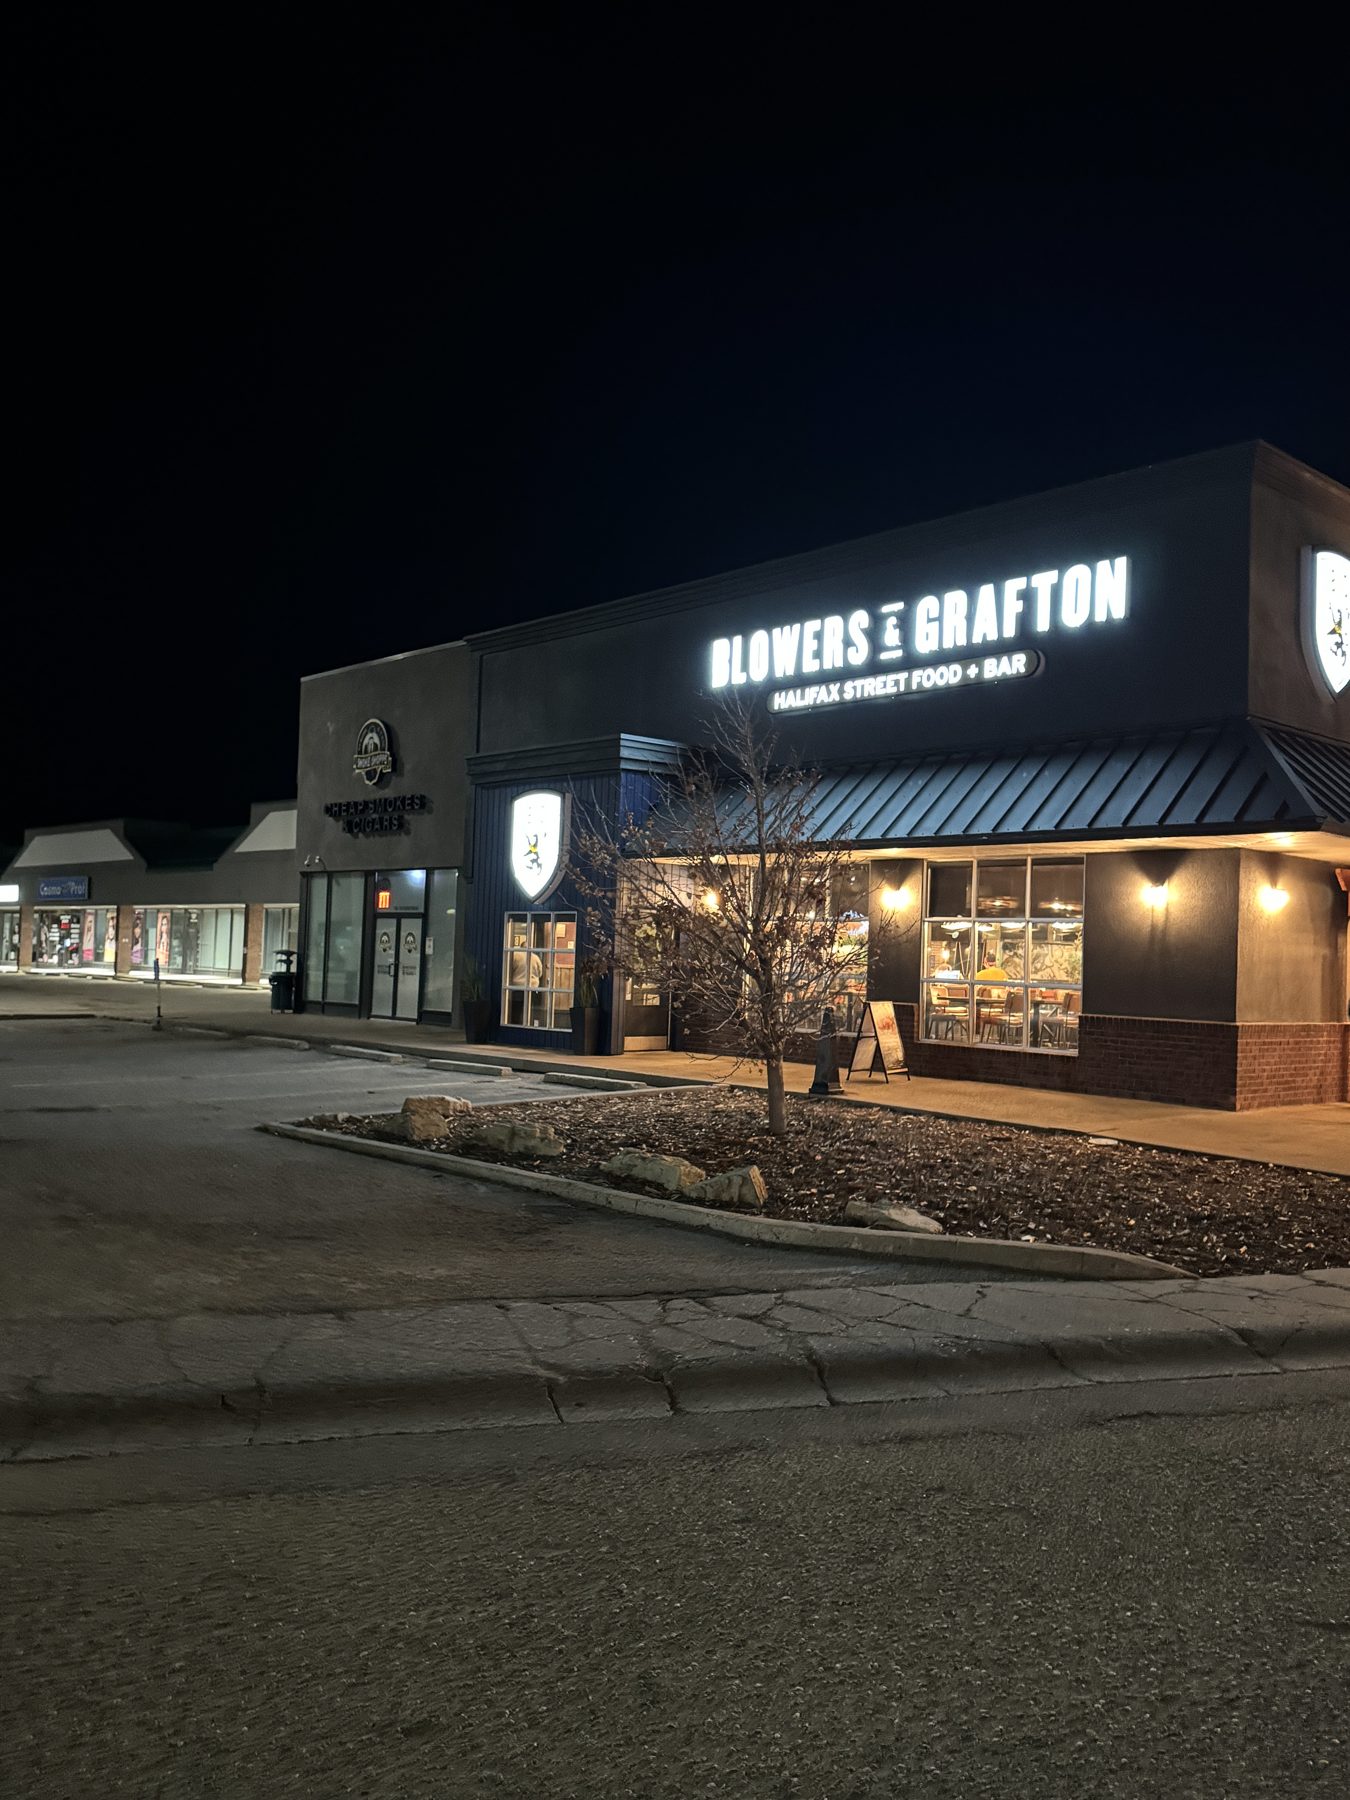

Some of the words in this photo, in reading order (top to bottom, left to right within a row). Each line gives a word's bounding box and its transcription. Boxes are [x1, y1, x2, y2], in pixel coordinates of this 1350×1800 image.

[711, 609, 870, 689] BLOWERS
[915, 556, 1129, 654] GRAFTON
[772, 684, 840, 711] HALIFAX
[843, 673, 909, 700] STREET
[911, 663, 962, 691] FOOD
[984, 653, 1026, 679] BAR
[352, 814, 400, 833] CIGARS
[368, 794, 424, 814] SMOKES
